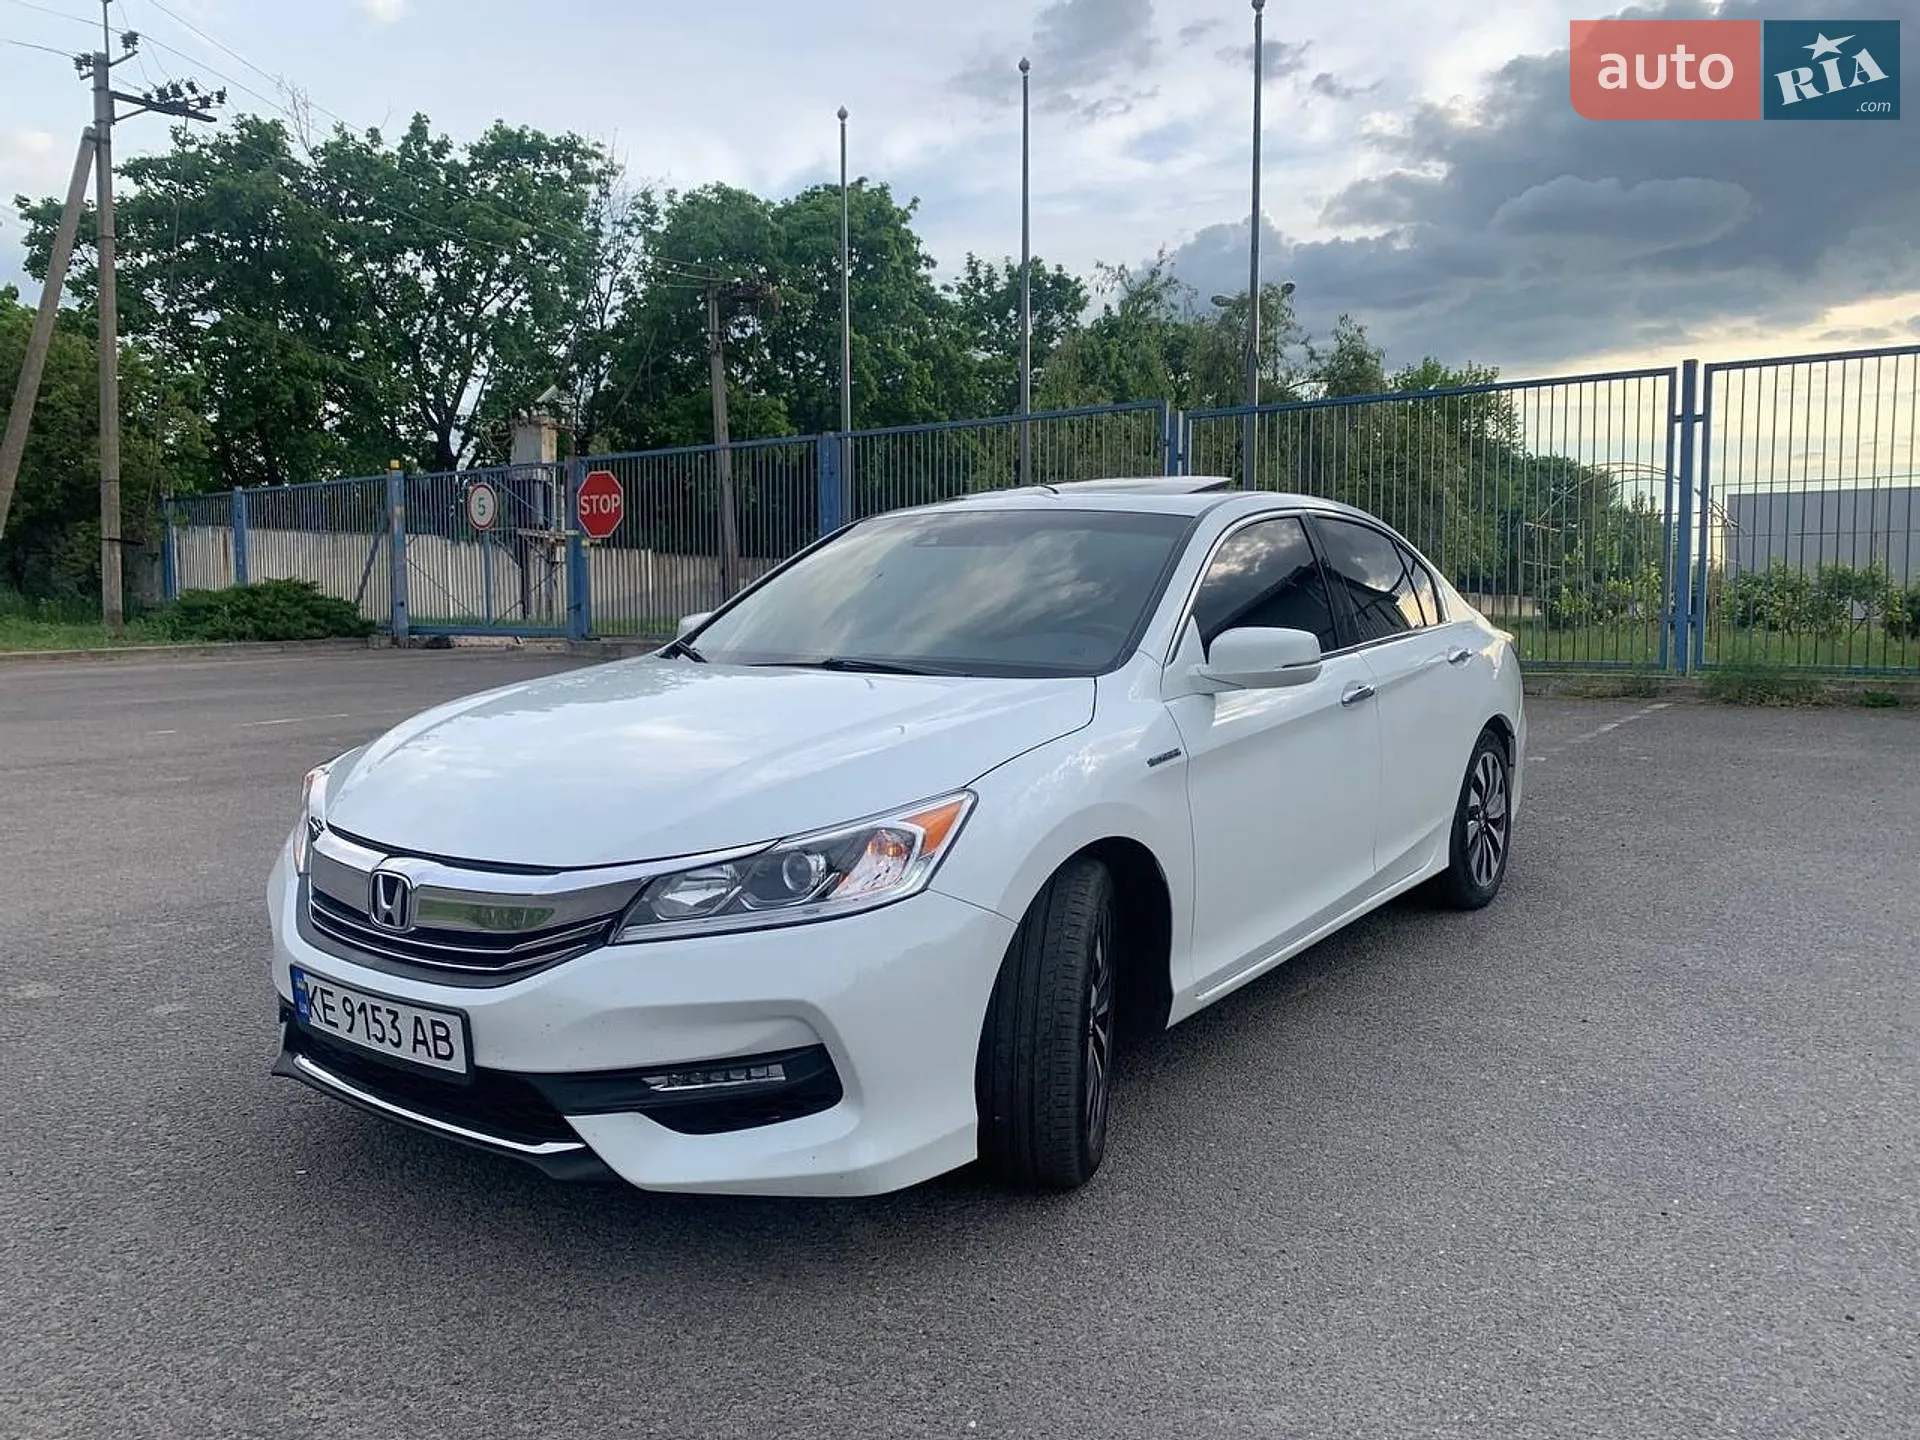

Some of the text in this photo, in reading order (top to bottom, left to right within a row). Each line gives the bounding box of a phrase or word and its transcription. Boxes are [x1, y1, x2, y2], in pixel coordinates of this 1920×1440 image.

[477, 496, 487, 517] 5
[580, 494, 621, 516] STOP
[304, 981, 455, 1061] KE 9153 AB
